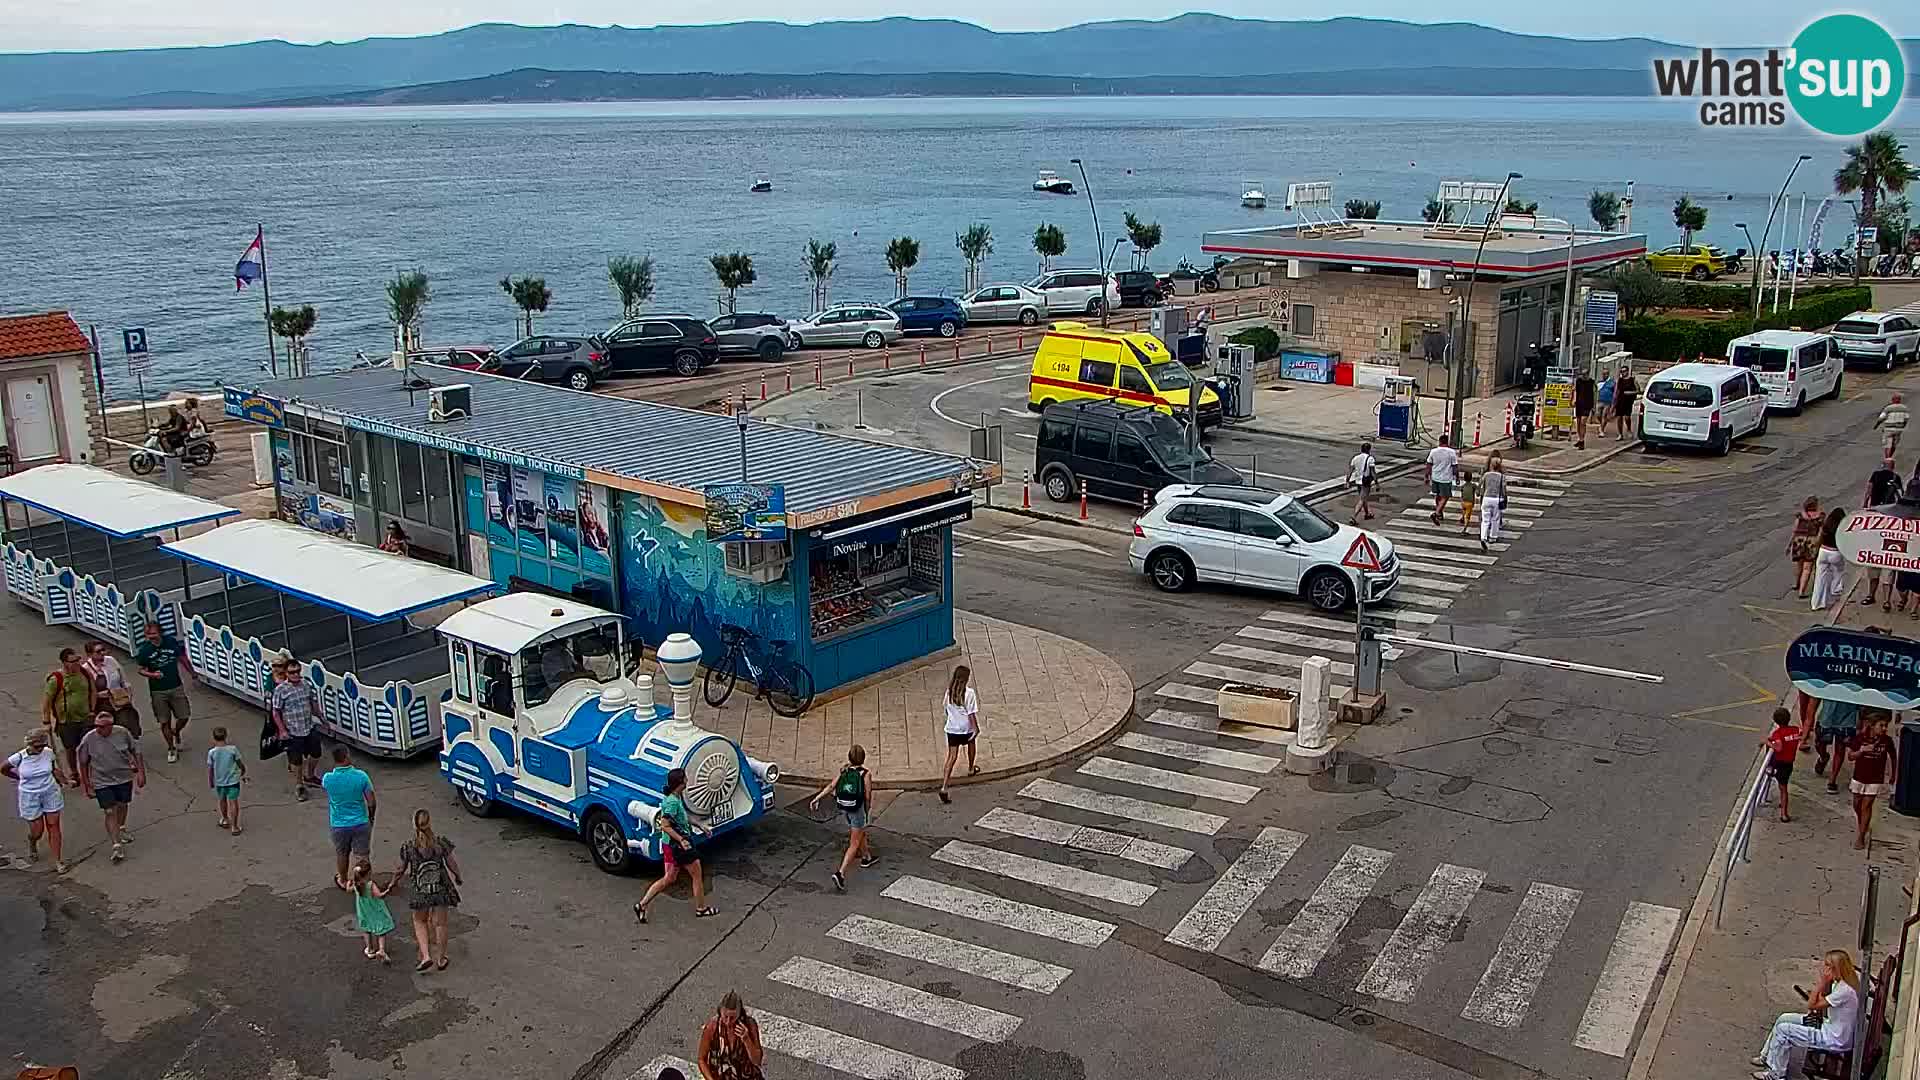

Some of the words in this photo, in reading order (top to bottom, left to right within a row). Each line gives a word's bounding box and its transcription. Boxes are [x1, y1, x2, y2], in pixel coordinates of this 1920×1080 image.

[435, 436, 467, 452] POSTAJA
[477, 446, 491, 458] BUS
[493, 451, 524, 465] STATION
[528, 458, 552, 471] TICKET
[554, 463, 581, 477] OFFICE
[1845, 516, 1920, 534] PIZZE
[1868, 666, 1895, 680] bar
